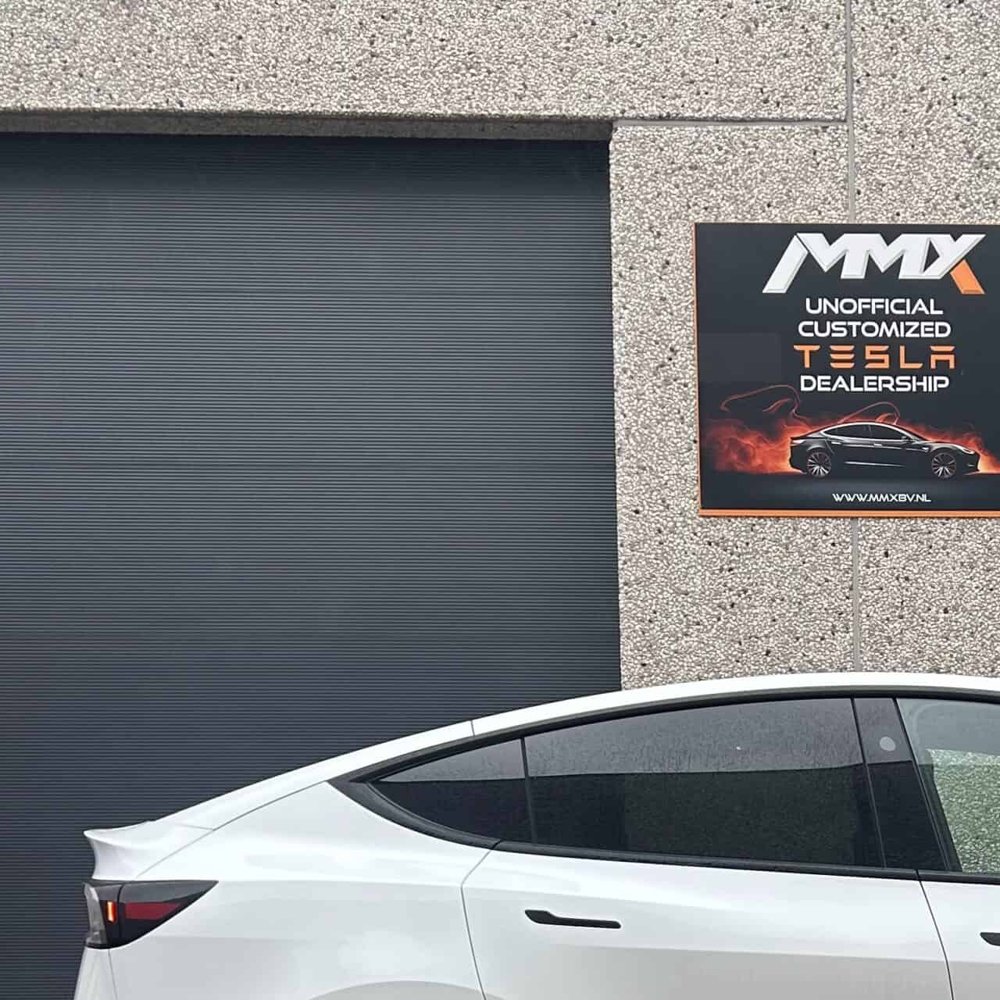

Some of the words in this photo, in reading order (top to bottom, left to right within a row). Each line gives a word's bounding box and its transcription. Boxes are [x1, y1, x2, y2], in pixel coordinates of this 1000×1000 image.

[762, 232, 986, 294] MMX
[805, 298, 944, 315] UNOFFICIAL
[797, 320, 952, 338] CUSTOMIZED
[793, 344, 956, 370] TESLA
[800, 375, 950, 393] DEALERSHIP
[831, 493, 932, 503] WWW.MMXBV.NL
